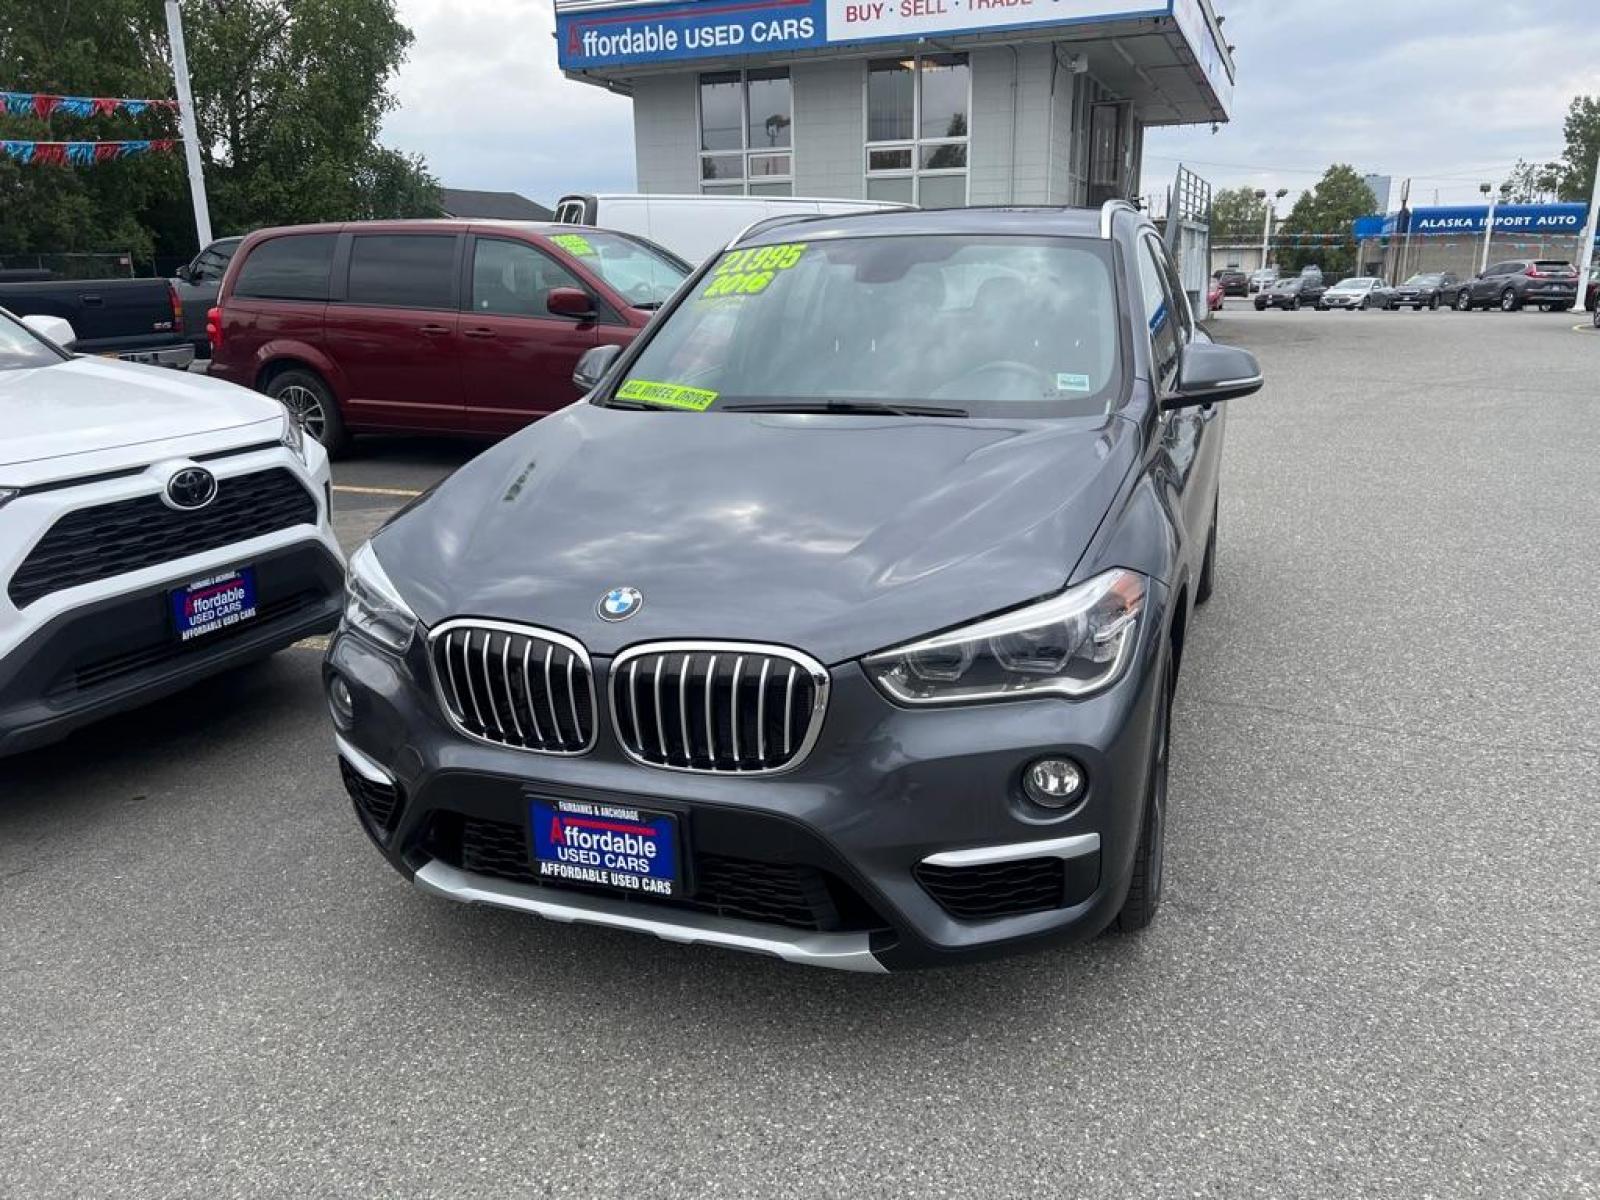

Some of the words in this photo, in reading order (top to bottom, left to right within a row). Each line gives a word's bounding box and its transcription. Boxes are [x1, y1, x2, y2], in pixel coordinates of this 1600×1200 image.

[846, 3, 884, 22] BUY
[900, 0, 948, 17] SELL
[567, 23, 678, 57] Affordable
[685, 25, 744, 48] USED
[751, 17, 815, 43] CARS
[1420, 218, 1473, 228] ALASKA
[1538, 216, 1576, 225] AUTO
[189, 611, 214, 626] USED
[217, 602, 241, 616] CARS
[551, 817, 656, 858] Affordable
[556, 846, 601, 866] USED
[604, 854, 650, 874] CARS
[540, 861, 609, 884] AFFORDABLE
[611, 872, 640, 890] USED
[641, 878, 672, 896] CARS
